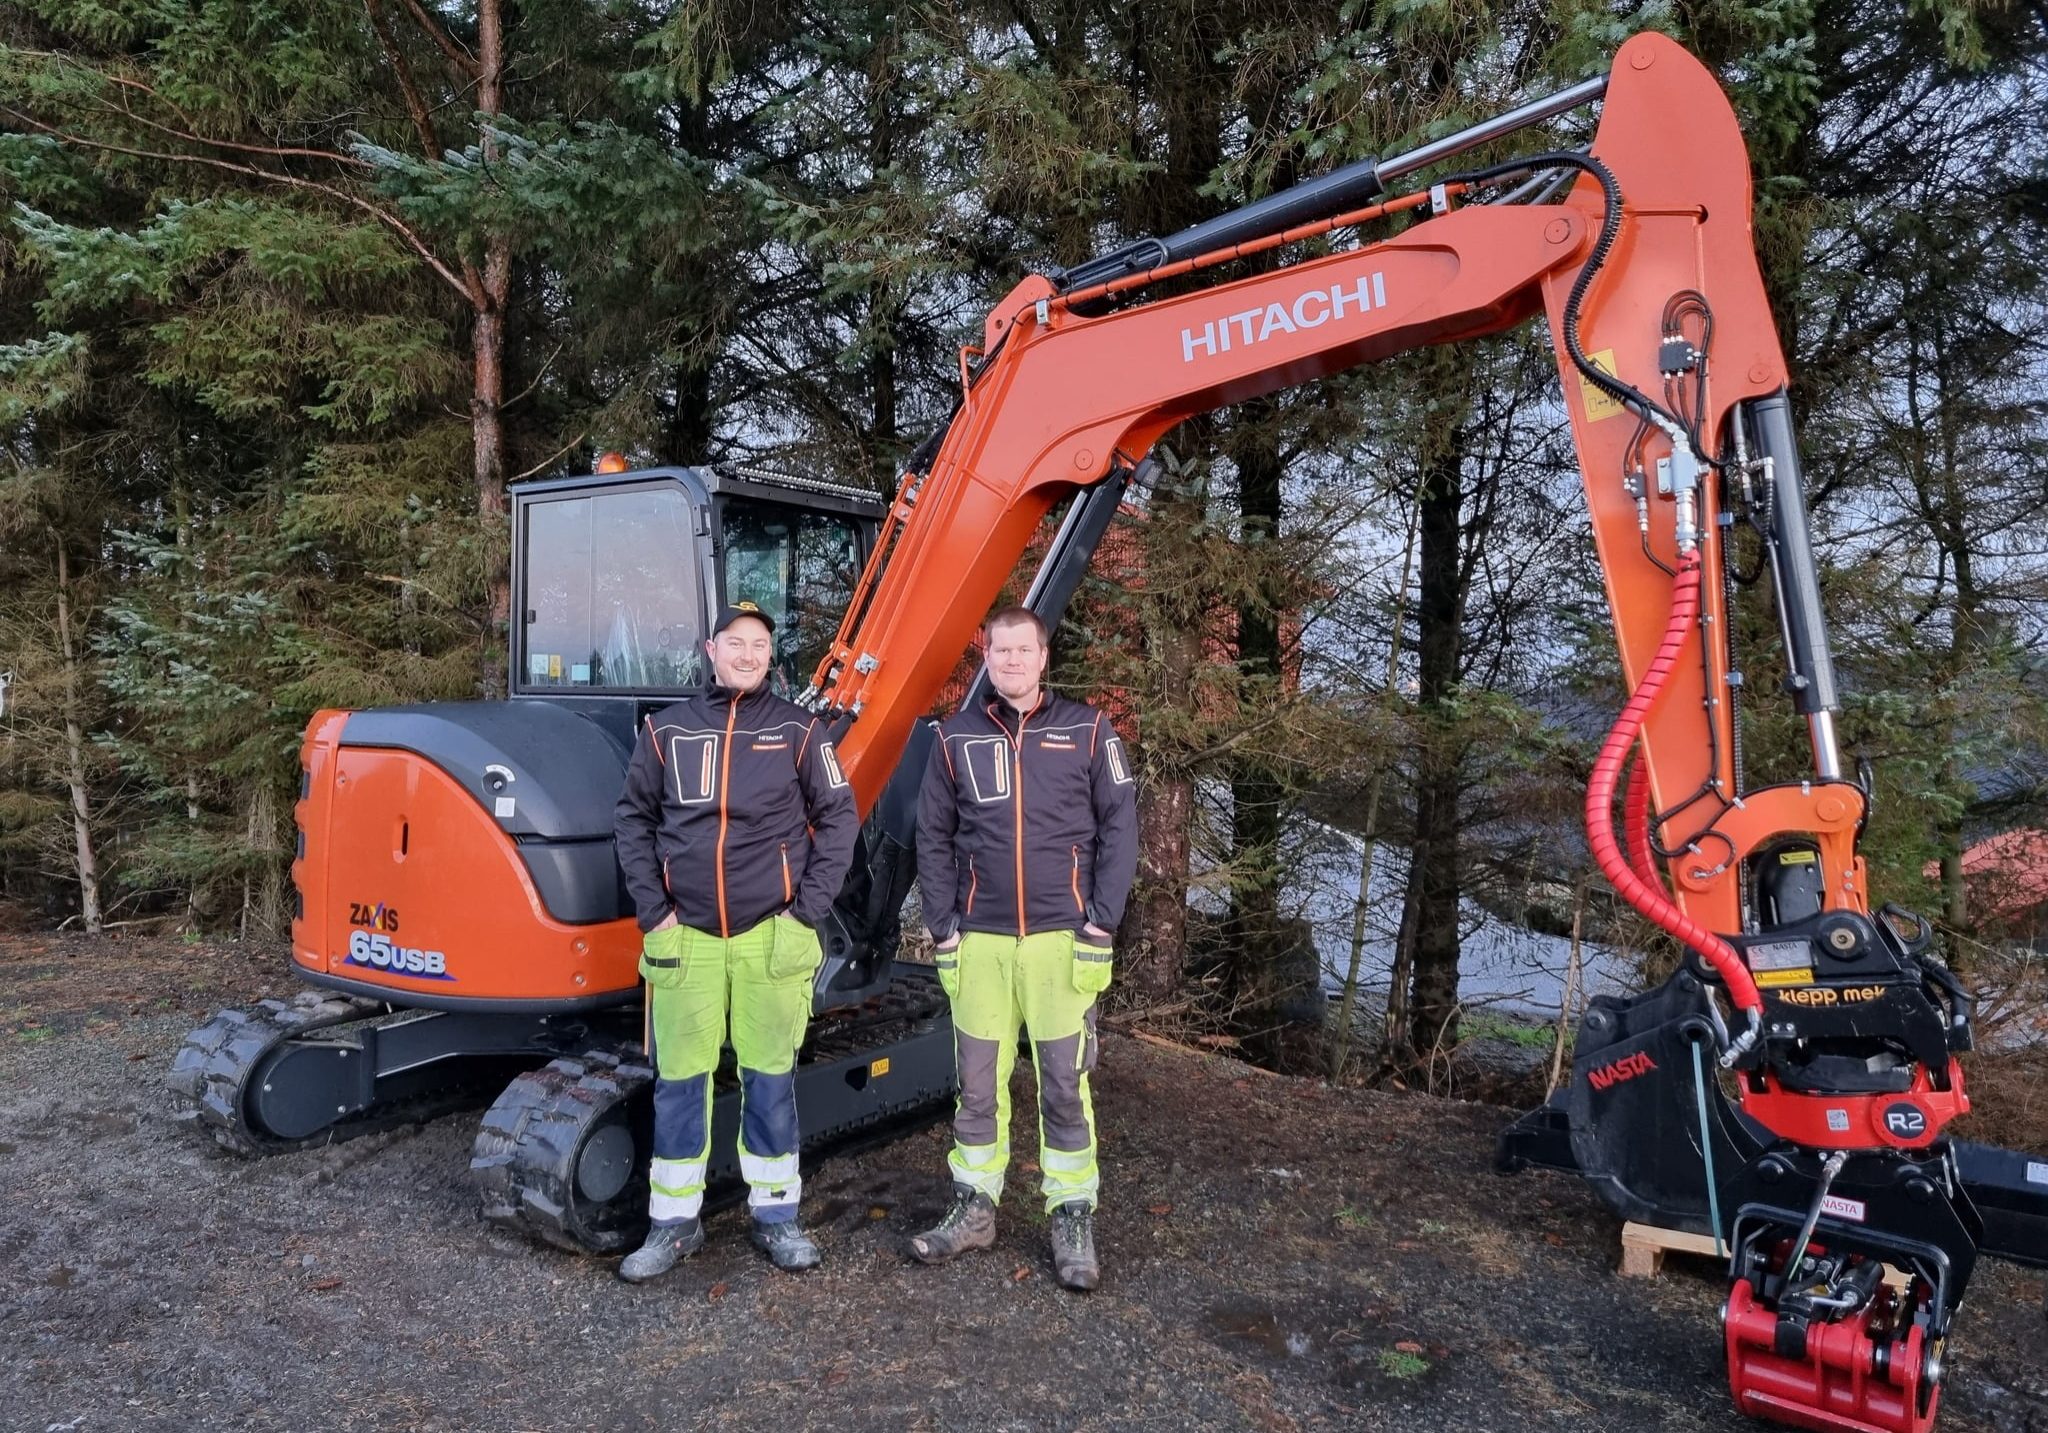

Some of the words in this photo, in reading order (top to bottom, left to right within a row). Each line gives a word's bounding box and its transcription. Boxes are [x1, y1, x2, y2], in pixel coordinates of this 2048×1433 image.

[1181, 272, 1387, 363] HITACHI
[758, 734, 783, 742] HITACHI
[349, 902, 399, 932] ZAXIS
[1773, 942, 1798, 950] NASTA
[1778, 988, 1837, 1008] klepp
[1587, 1050, 1659, 1090] NASTA
[1887, 1112, 1925, 1131] R2
[1821, 1198, 1858, 1215] NASTA
